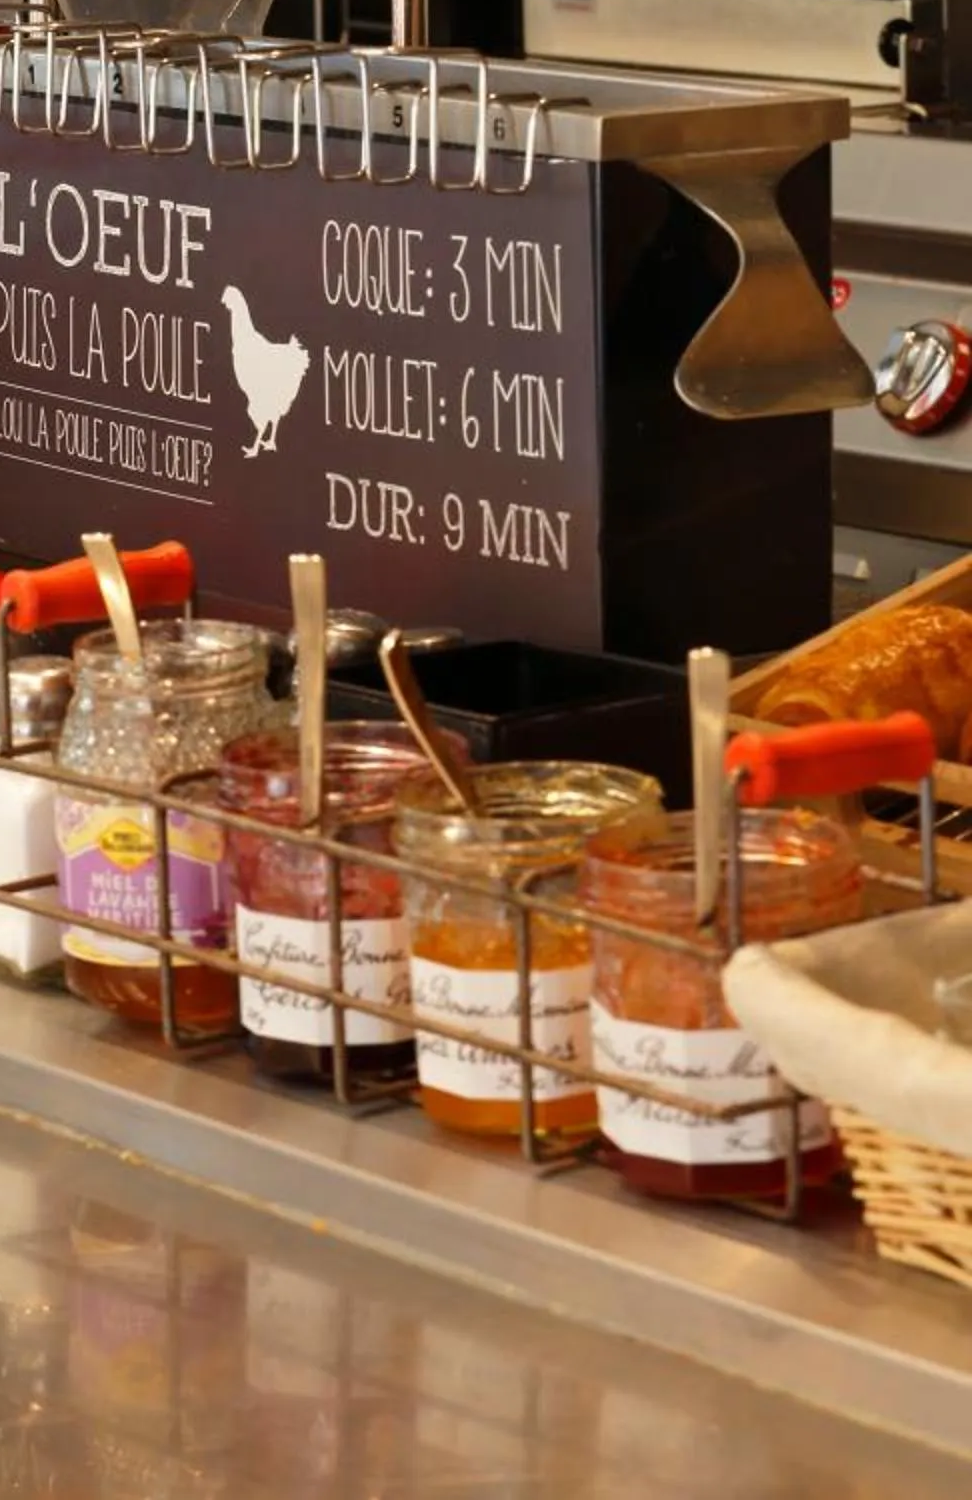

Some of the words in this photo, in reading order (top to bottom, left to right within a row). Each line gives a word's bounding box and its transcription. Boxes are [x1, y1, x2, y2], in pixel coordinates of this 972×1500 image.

[27, 63, 36, 85] 1
[112, 72, 123, 95] 2
[392, 105, 403, 128] 5
[493, 116, 506, 141] 6
[322, 219, 433, 316] COQUE:
[449, 234, 470, 322] 3
[485, 236, 563, 334] MIN
[69, 295, 109, 384] LA
[122, 306, 212, 405] POULE
[28, 402, 51, 451] LA
[55, 408, 104, 464] POULE
[109, 420, 147, 473] PUIS
[152, 429, 213, 487] L'OEUF?
[323, 345, 447, 443] MOLLET:
[461, 366, 480, 449] 6
[493, 369, 565, 461] MIN
[325, 471, 426, 545] DUR:
[443, 491, 465, 552] 9
[479, 499, 572, 572] MIN
